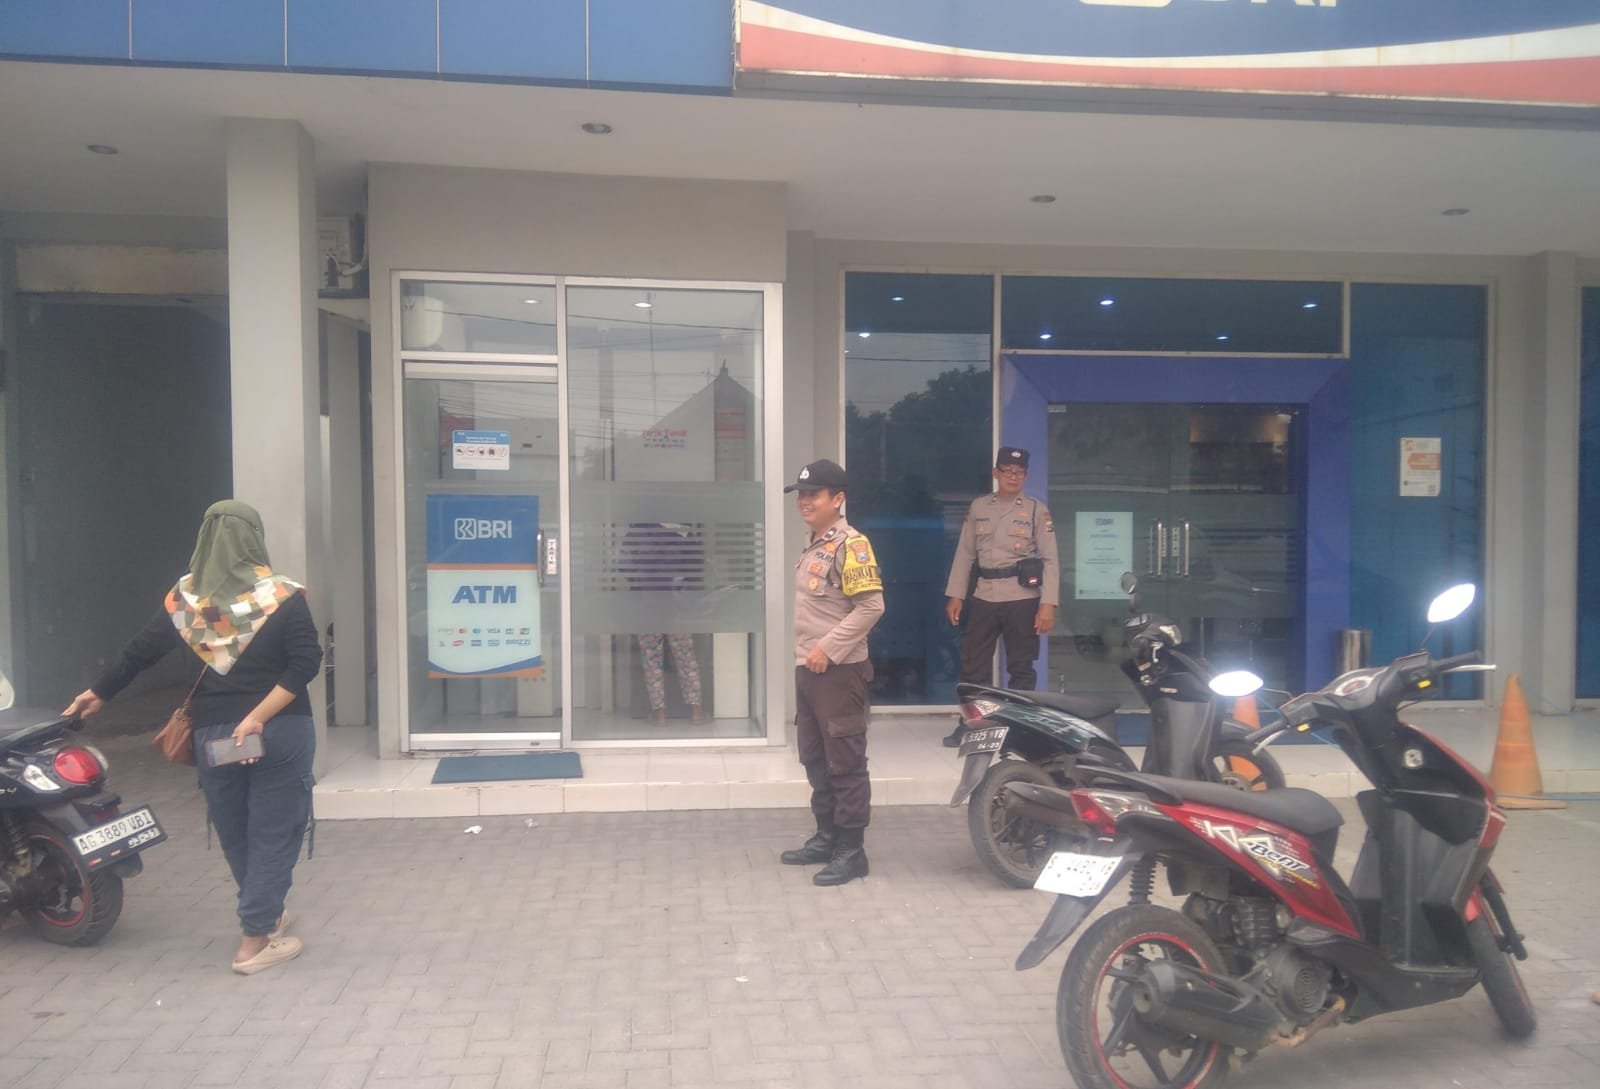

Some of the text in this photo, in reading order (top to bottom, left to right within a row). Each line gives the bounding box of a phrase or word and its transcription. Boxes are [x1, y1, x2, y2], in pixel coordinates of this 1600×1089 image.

[478, 520, 513, 539] BRI
[452, 585, 517, 604] ATM
[78, 834, 97, 851] AG
[95, 822, 127, 844] 3889
